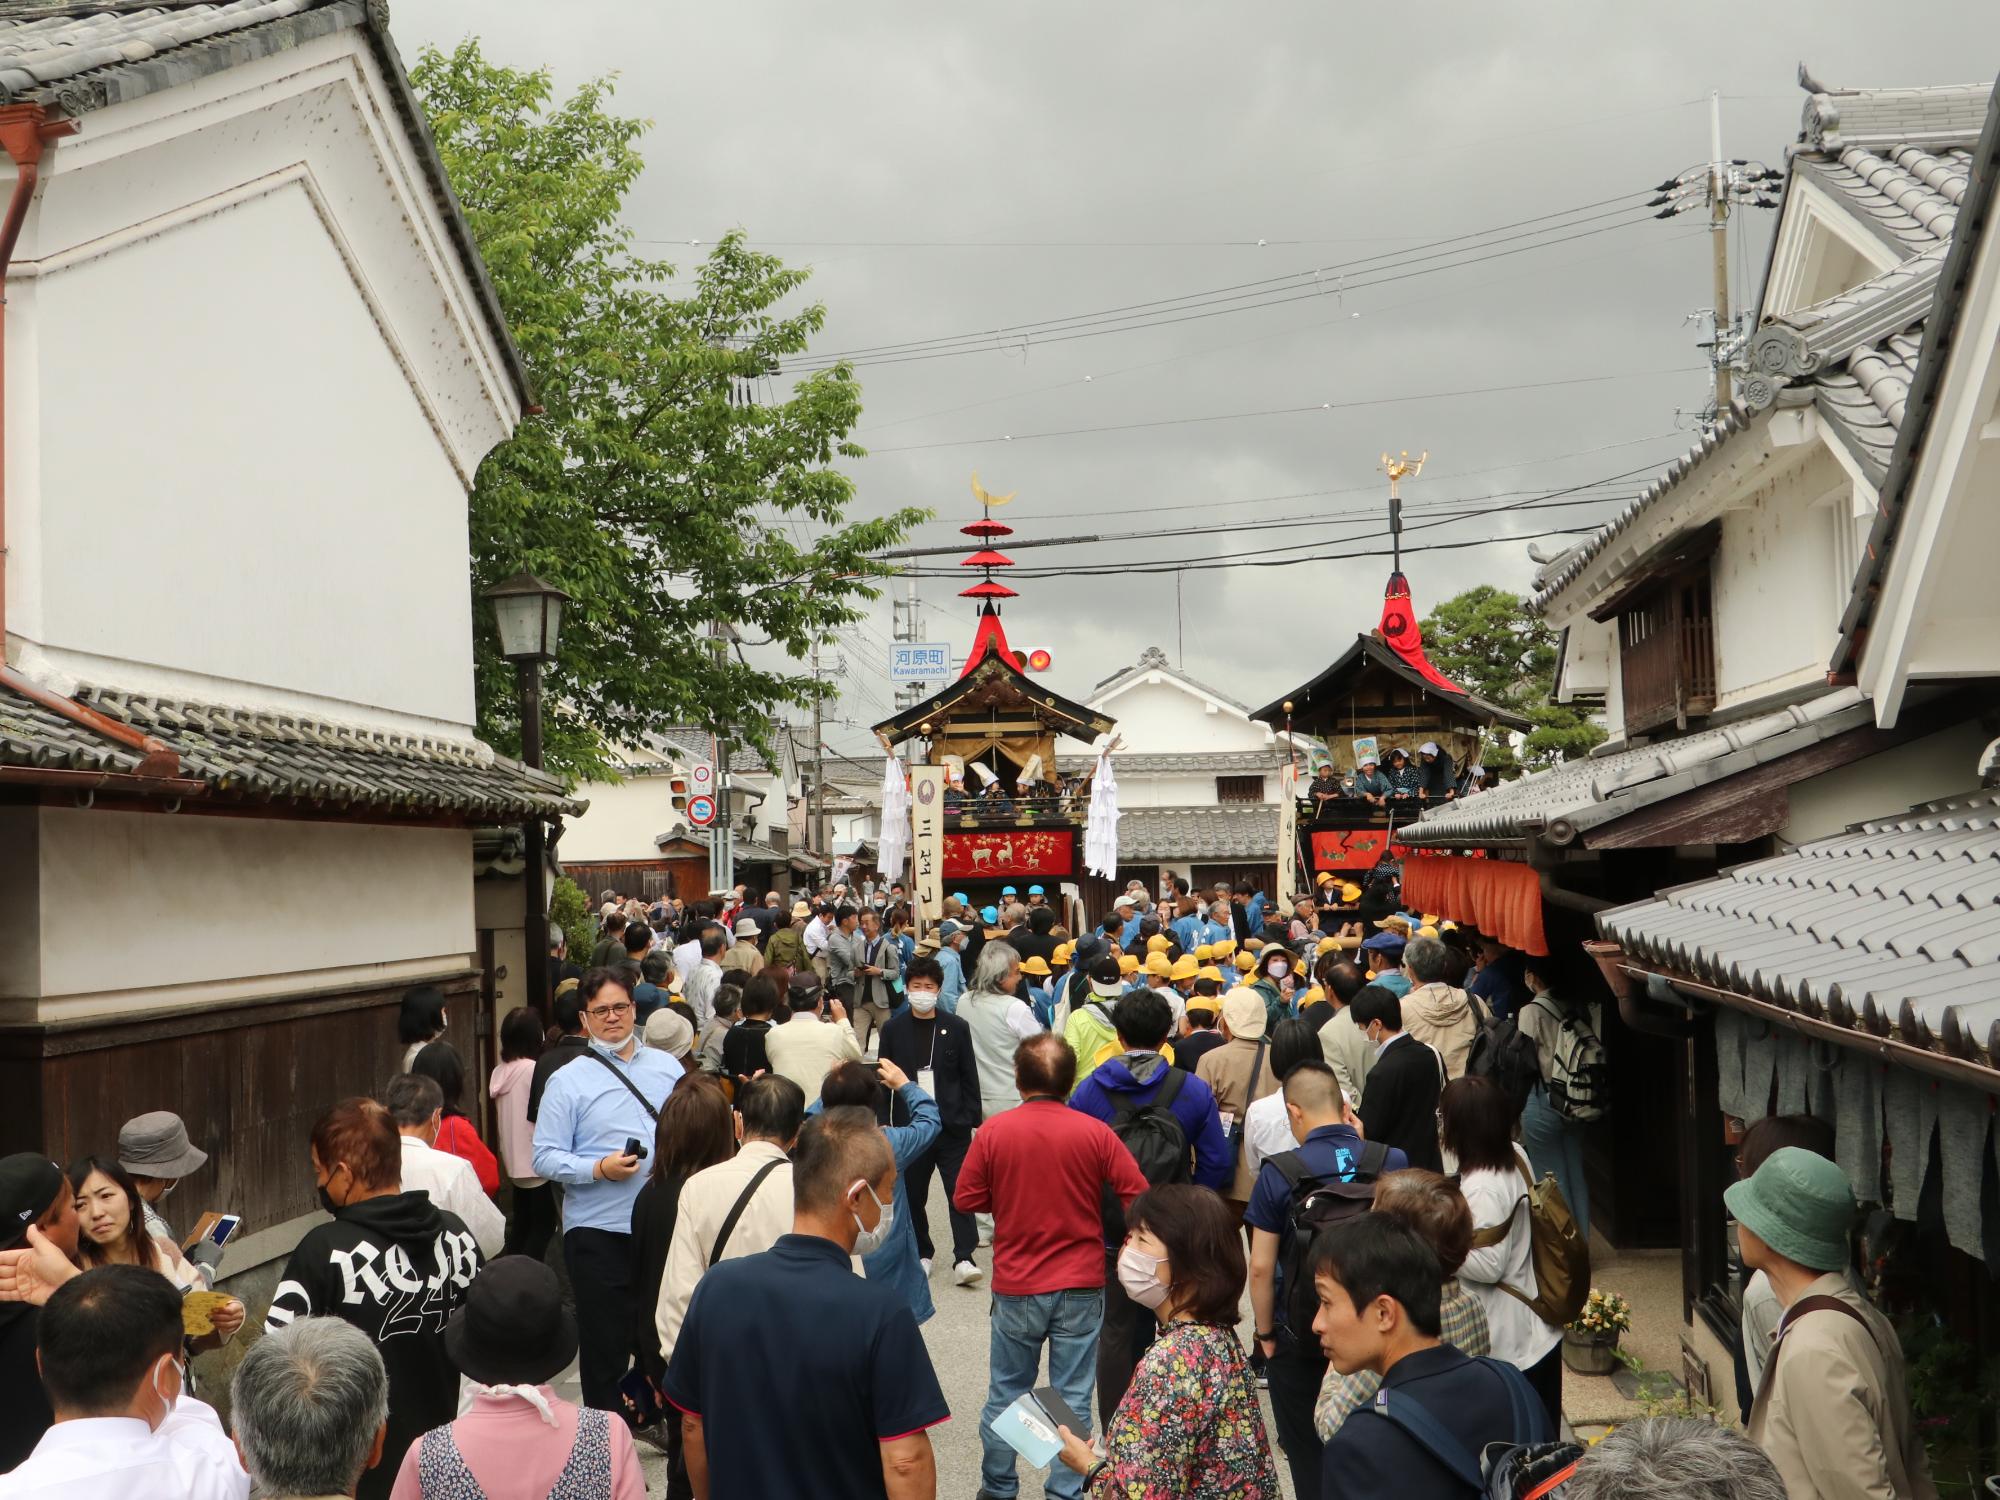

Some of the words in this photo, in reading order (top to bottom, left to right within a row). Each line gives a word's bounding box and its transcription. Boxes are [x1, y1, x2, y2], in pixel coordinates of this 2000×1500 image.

[896, 650, 945, 665] 河原町
[893, 665, 947, 675] Kawaramachi
